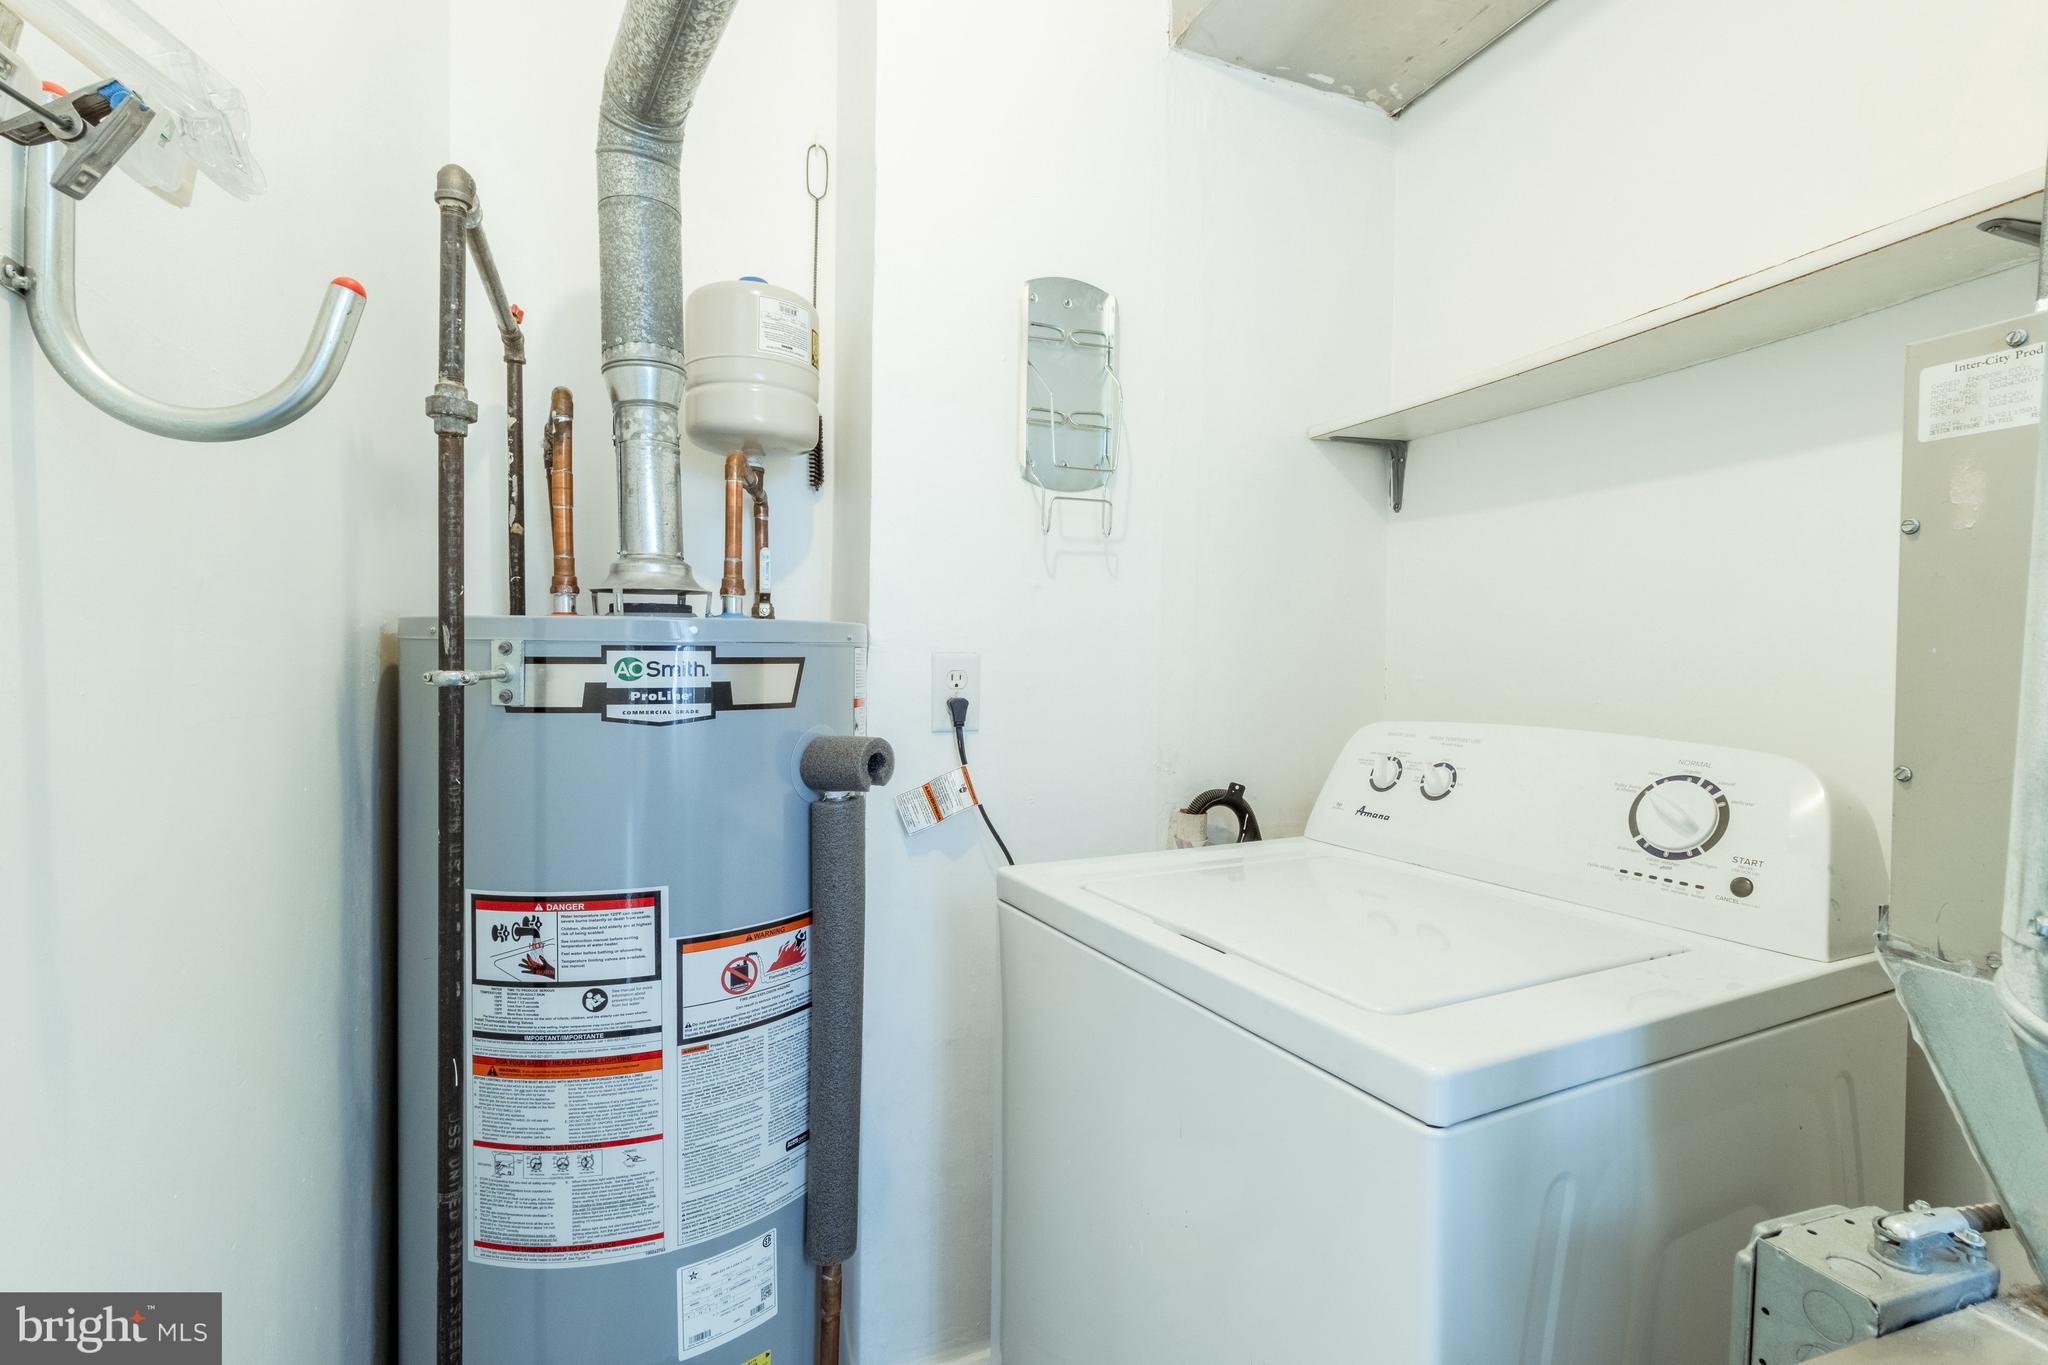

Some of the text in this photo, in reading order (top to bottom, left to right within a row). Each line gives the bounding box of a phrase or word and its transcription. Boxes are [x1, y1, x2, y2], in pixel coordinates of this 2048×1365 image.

[1954, 345, 2044, 372] Inter-City Prod
[631, 691, 690, 701] ProLine
[1679, 759, 1713, 769] NORMAL
[1355, 805, 1390, 821] Amana
[1732, 856, 1765, 868] START
[1715, 895, 1739, 905] CANCEL
[546, 903, 585, 911] DANGER
[753, 926, 786, 940] WARNING
[523, 1033, 604, 1041] IMPORTANT/IMPORTANTE
